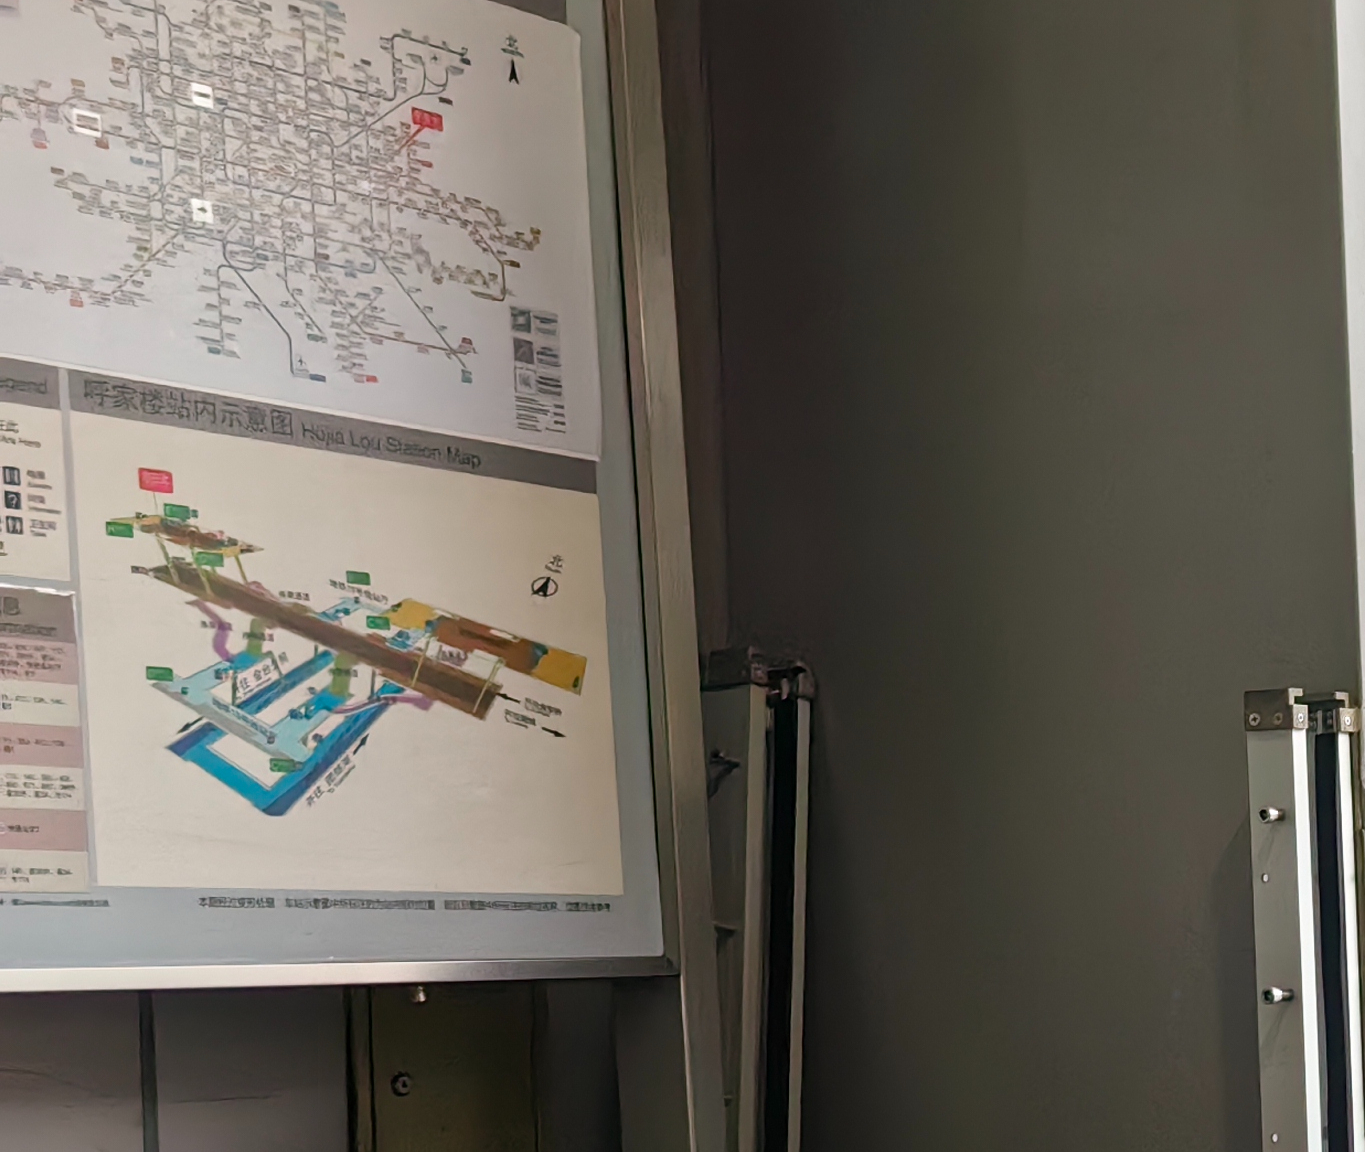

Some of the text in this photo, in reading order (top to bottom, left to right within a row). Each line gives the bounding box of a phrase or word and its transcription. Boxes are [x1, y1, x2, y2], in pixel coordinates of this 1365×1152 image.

[83, 378, 294, 436] 呼家楼站内示意图
[446, 446, 481, 469] Map
